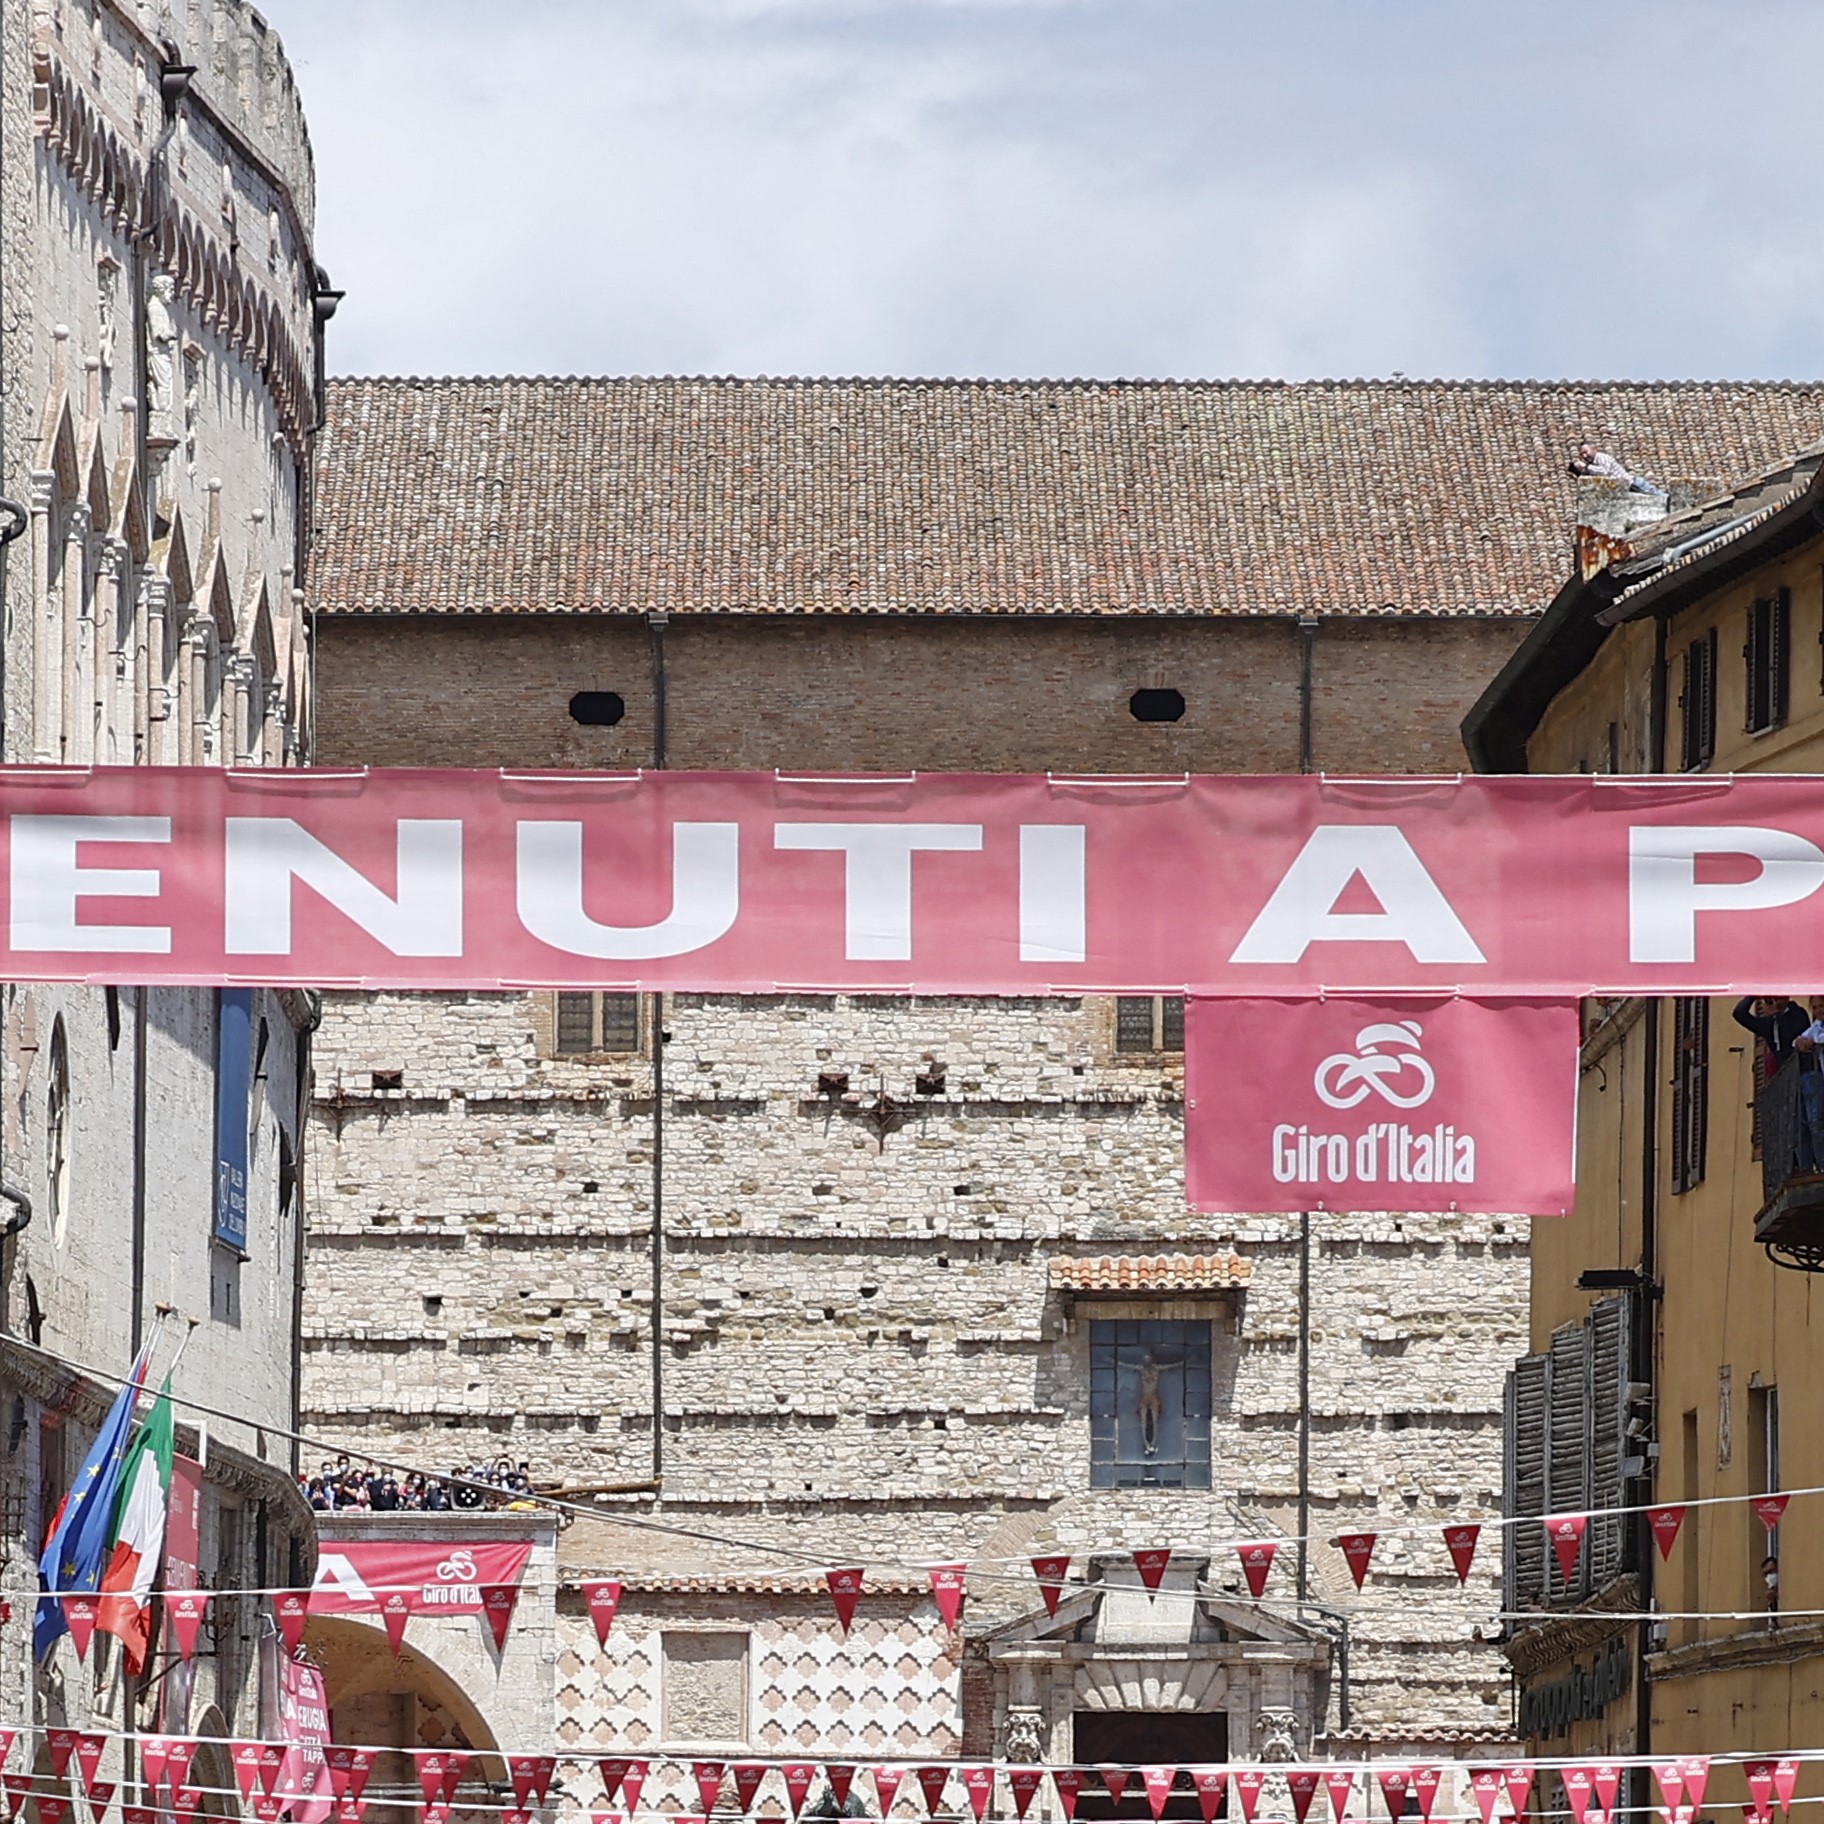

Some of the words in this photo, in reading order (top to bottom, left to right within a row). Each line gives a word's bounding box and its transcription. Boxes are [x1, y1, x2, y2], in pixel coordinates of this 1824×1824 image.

[1229, 822, 1488, 965] A
[1272, 1124, 1348, 1184] Giro
[1356, 1122, 1474, 1184] d'Italia
[422, 1584, 448, 1604] Giro
[298, 1705, 326, 1732] ERUGIA
